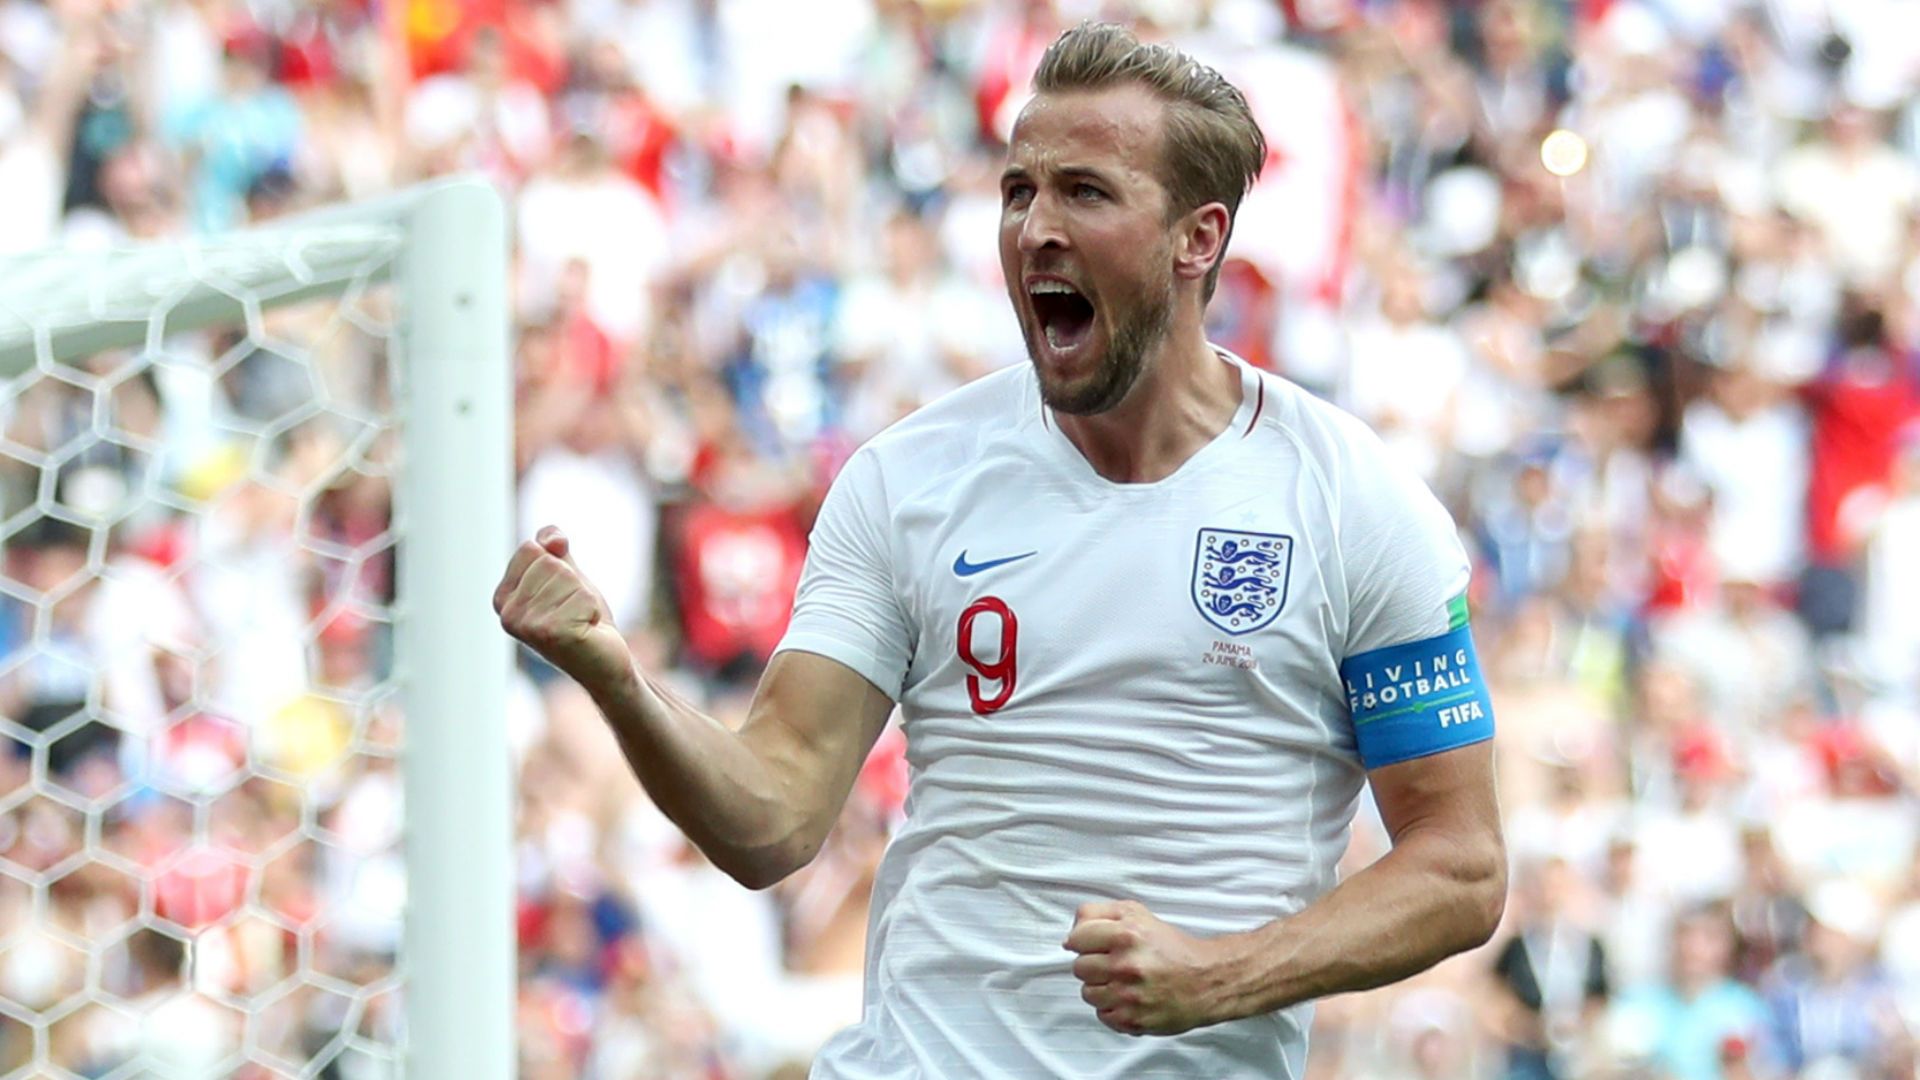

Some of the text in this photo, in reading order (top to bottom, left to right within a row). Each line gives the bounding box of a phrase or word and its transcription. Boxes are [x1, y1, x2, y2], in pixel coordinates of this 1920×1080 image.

[957, 596, 1017, 715] 9
[1212, 641, 1251, 656] PANAMA
[1347, 649, 1467, 695] LIVING
[1350, 668, 1471, 713] FOOTBALL
[1438, 701, 1484, 728] FIFA
